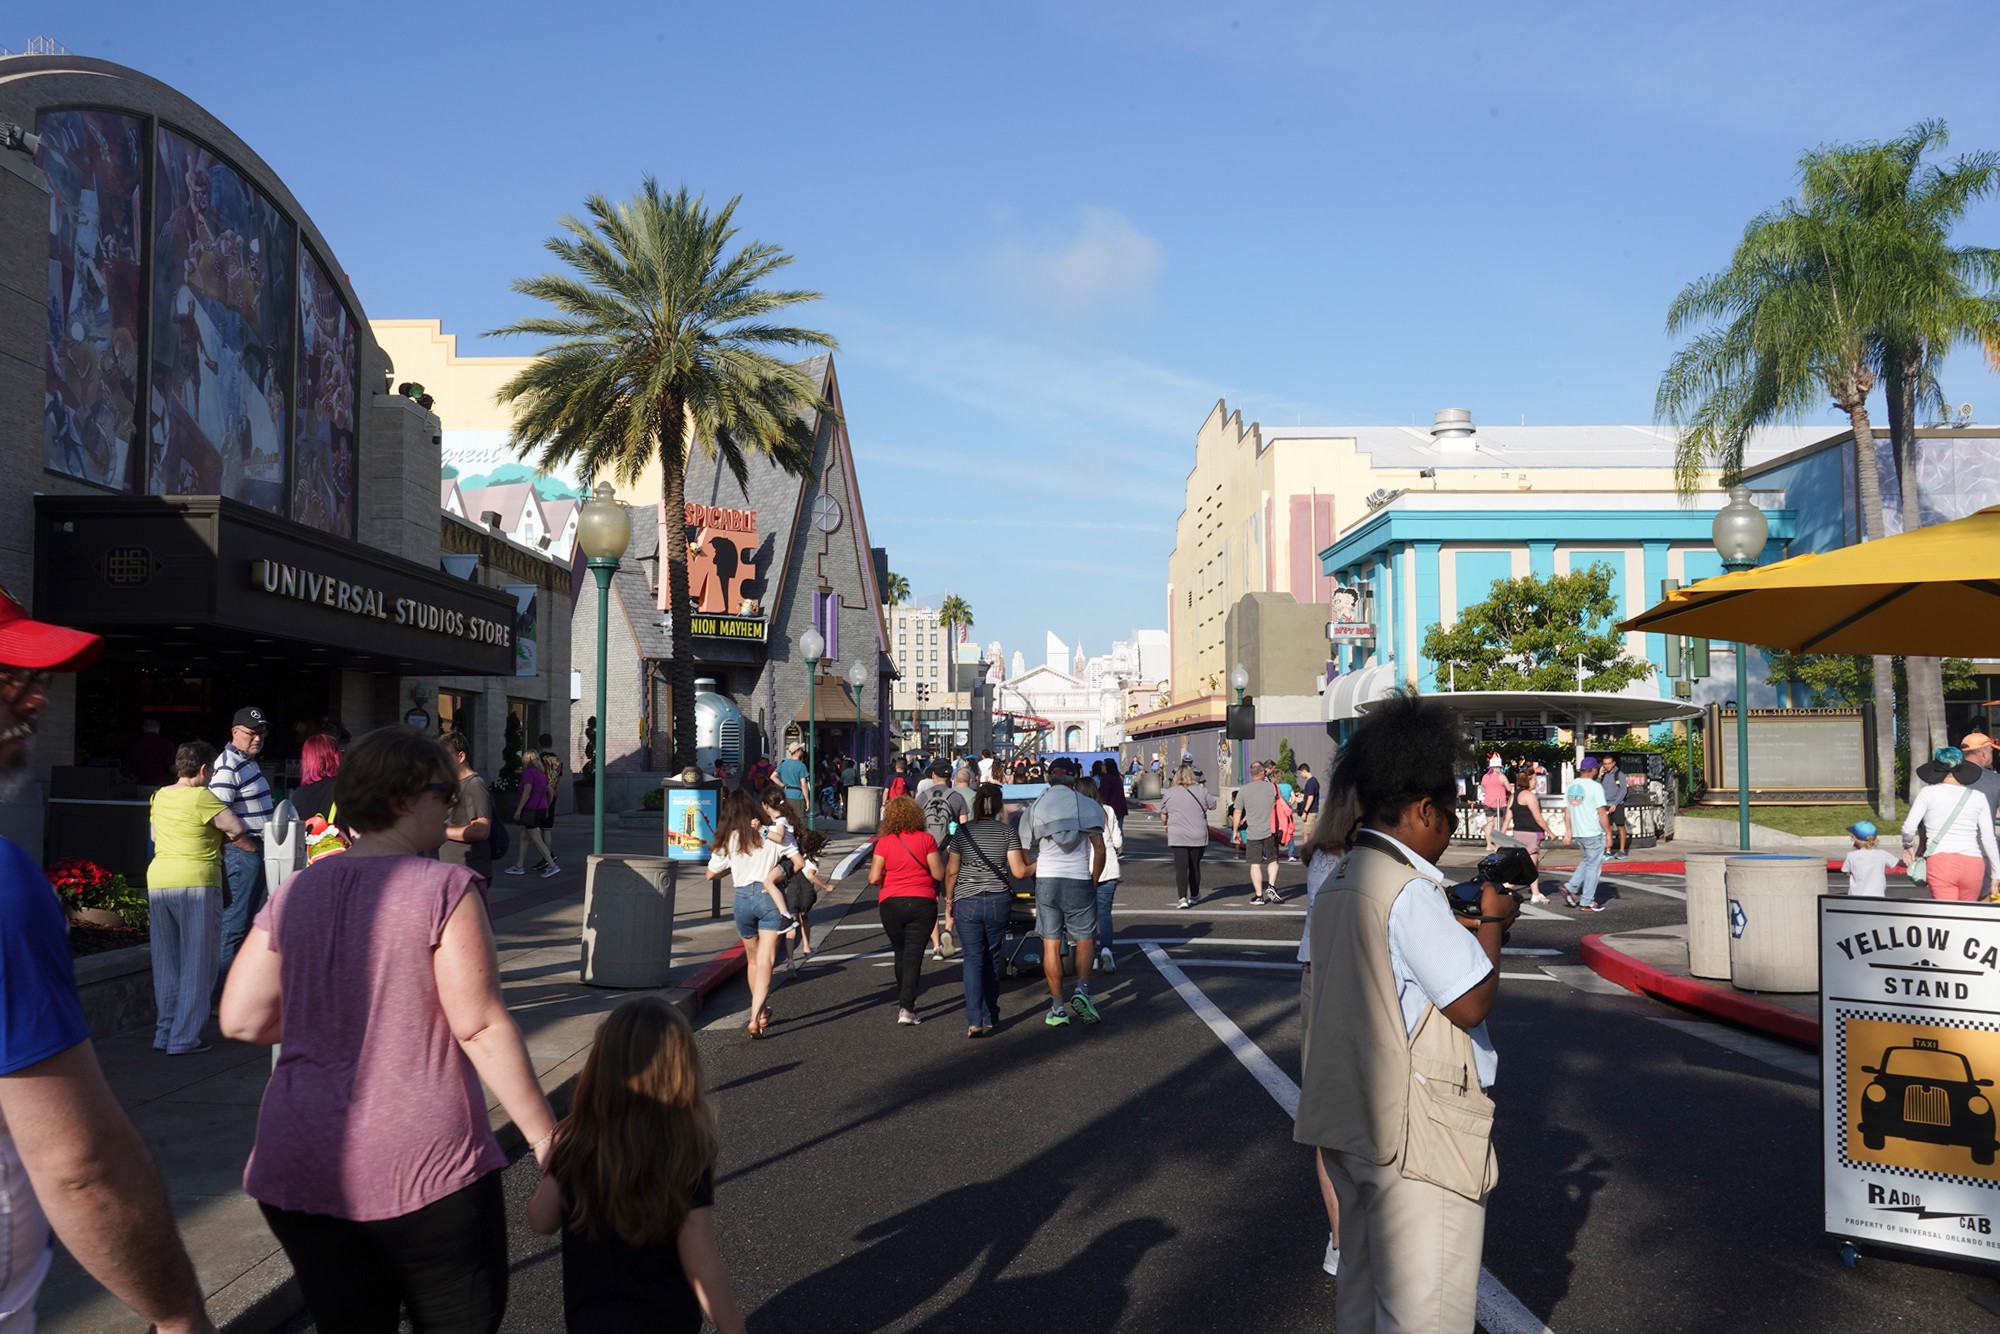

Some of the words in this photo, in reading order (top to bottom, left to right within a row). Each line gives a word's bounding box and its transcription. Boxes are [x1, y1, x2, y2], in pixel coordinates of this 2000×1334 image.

[684, 502, 758, 532] SPICABLE
[263, 558, 388, 619] UNIVERSAL
[394, 597, 464, 637] STUDIOS
[468, 616, 511, 648] STORE
[690, 618, 716, 635] NION
[719, 619, 763, 638] MAYHEM
[908, 613, 941, 622] COMCAS
[1836, 925, 1950, 961] YELLOW
[1963, 937, 2000, 972] CA
[1884, 976, 1969, 1000] STAND
[1915, 1039, 1937, 1049] TAXI
[1868, 1182, 1921, 1207] RADIO
[1845, 1217, 1883, 1230] PROPERTY
[1886, 1224, 1896, 1232] OF
[1899, 1226, 1942, 1240] UNIVERSAL
[1945, 1233, 1983, 1247] ORLANDO
[1959, 1216, 1992, 1235] CAB
